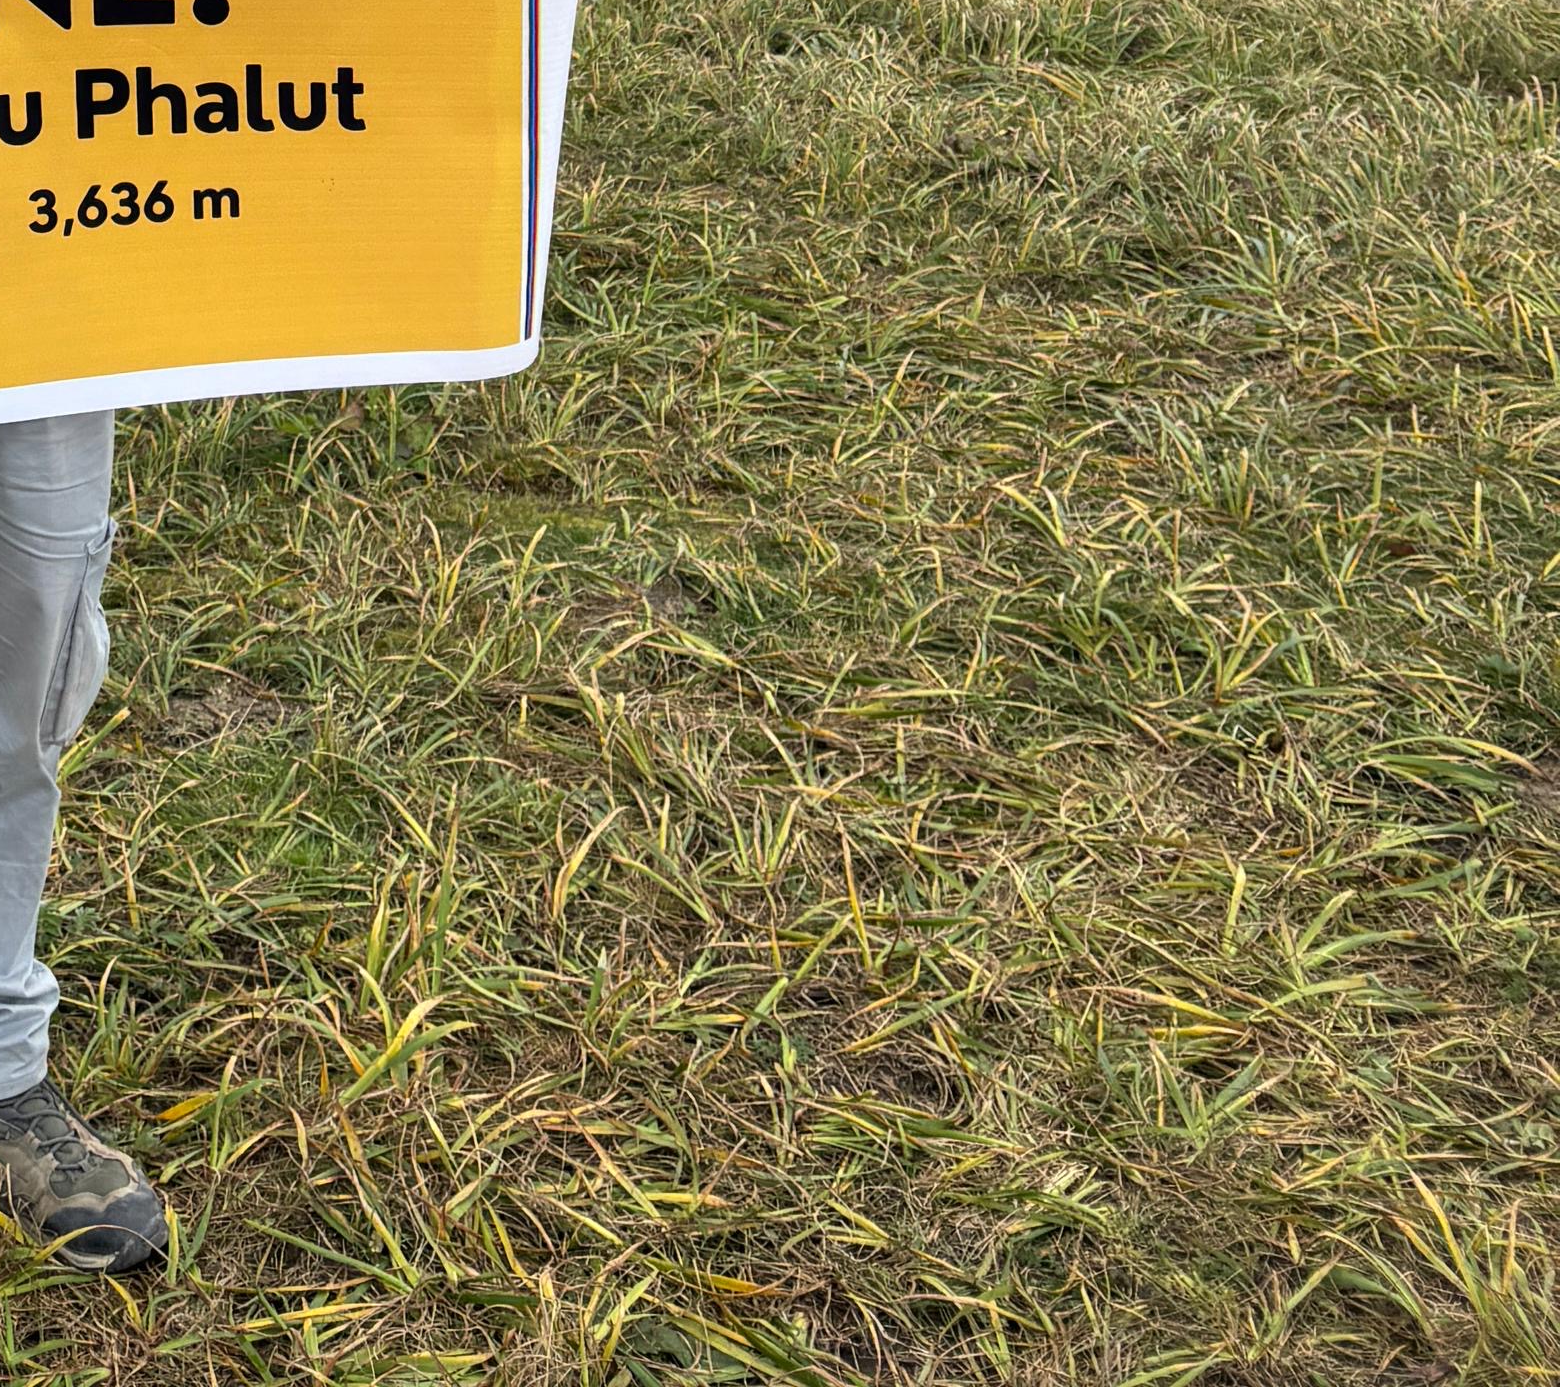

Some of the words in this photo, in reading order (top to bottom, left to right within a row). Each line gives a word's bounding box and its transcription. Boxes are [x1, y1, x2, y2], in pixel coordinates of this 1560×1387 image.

[75, 64, 367, 140] Phalut
[28, 180, 175, 237] 3,636
[192, 187, 240, 220] m
